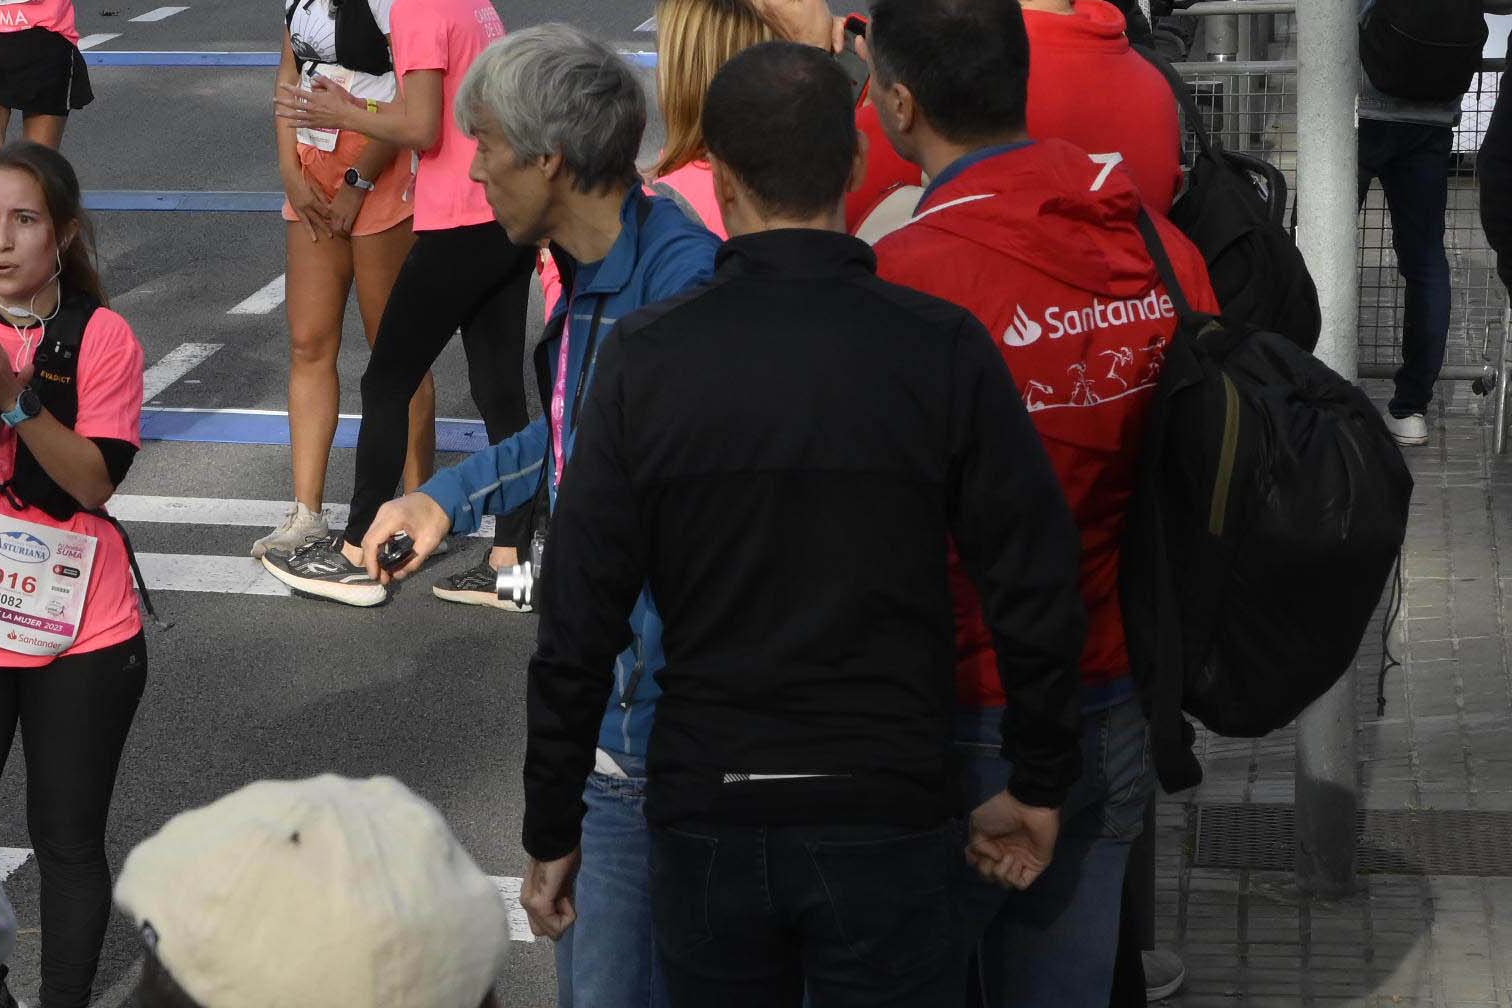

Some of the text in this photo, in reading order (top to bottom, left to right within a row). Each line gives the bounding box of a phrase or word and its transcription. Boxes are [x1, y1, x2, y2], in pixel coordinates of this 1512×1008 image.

[1045, 289, 1175, 339] Santande
[56, 548, 83, 559] SUMA
[2, 610, 13, 620] LA
[14, 614, 42, 627] MUJER
[44, 623, 64, 633] 2023
[18, 634, 62, 650] Santander
